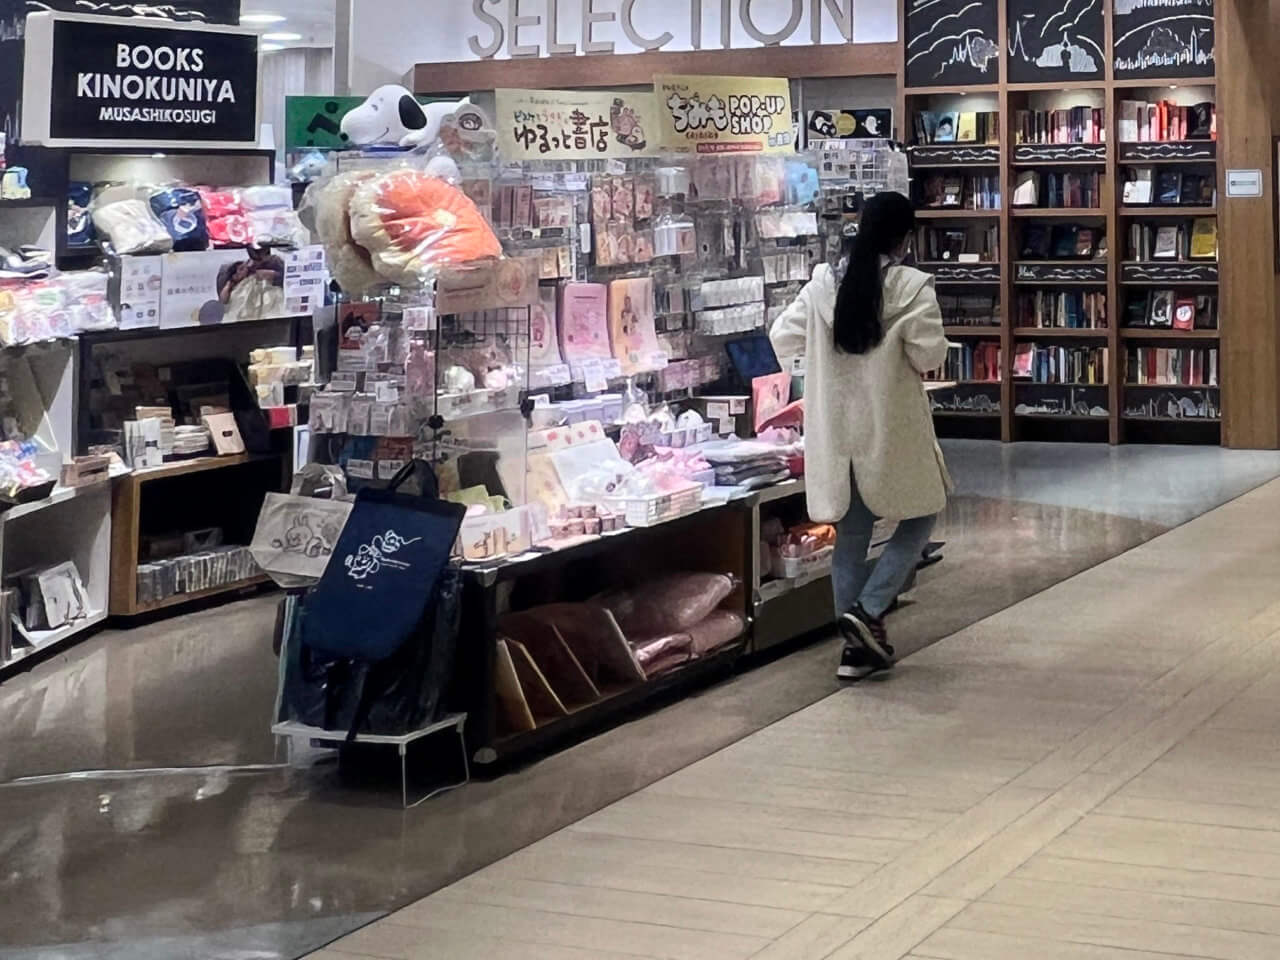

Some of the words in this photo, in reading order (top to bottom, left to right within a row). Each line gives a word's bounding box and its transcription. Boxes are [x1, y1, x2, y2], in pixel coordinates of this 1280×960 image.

[116, 43, 204, 72] BOOKS
[77, 73, 236, 103] KINOKUNIYA
[99, 106, 217, 124] MUSASHIKOSUGI
[728, 95, 785, 117] POP-UP
[513, 108, 610, 153] ゆるっと書店
[730, 115, 773, 135] SHOP
